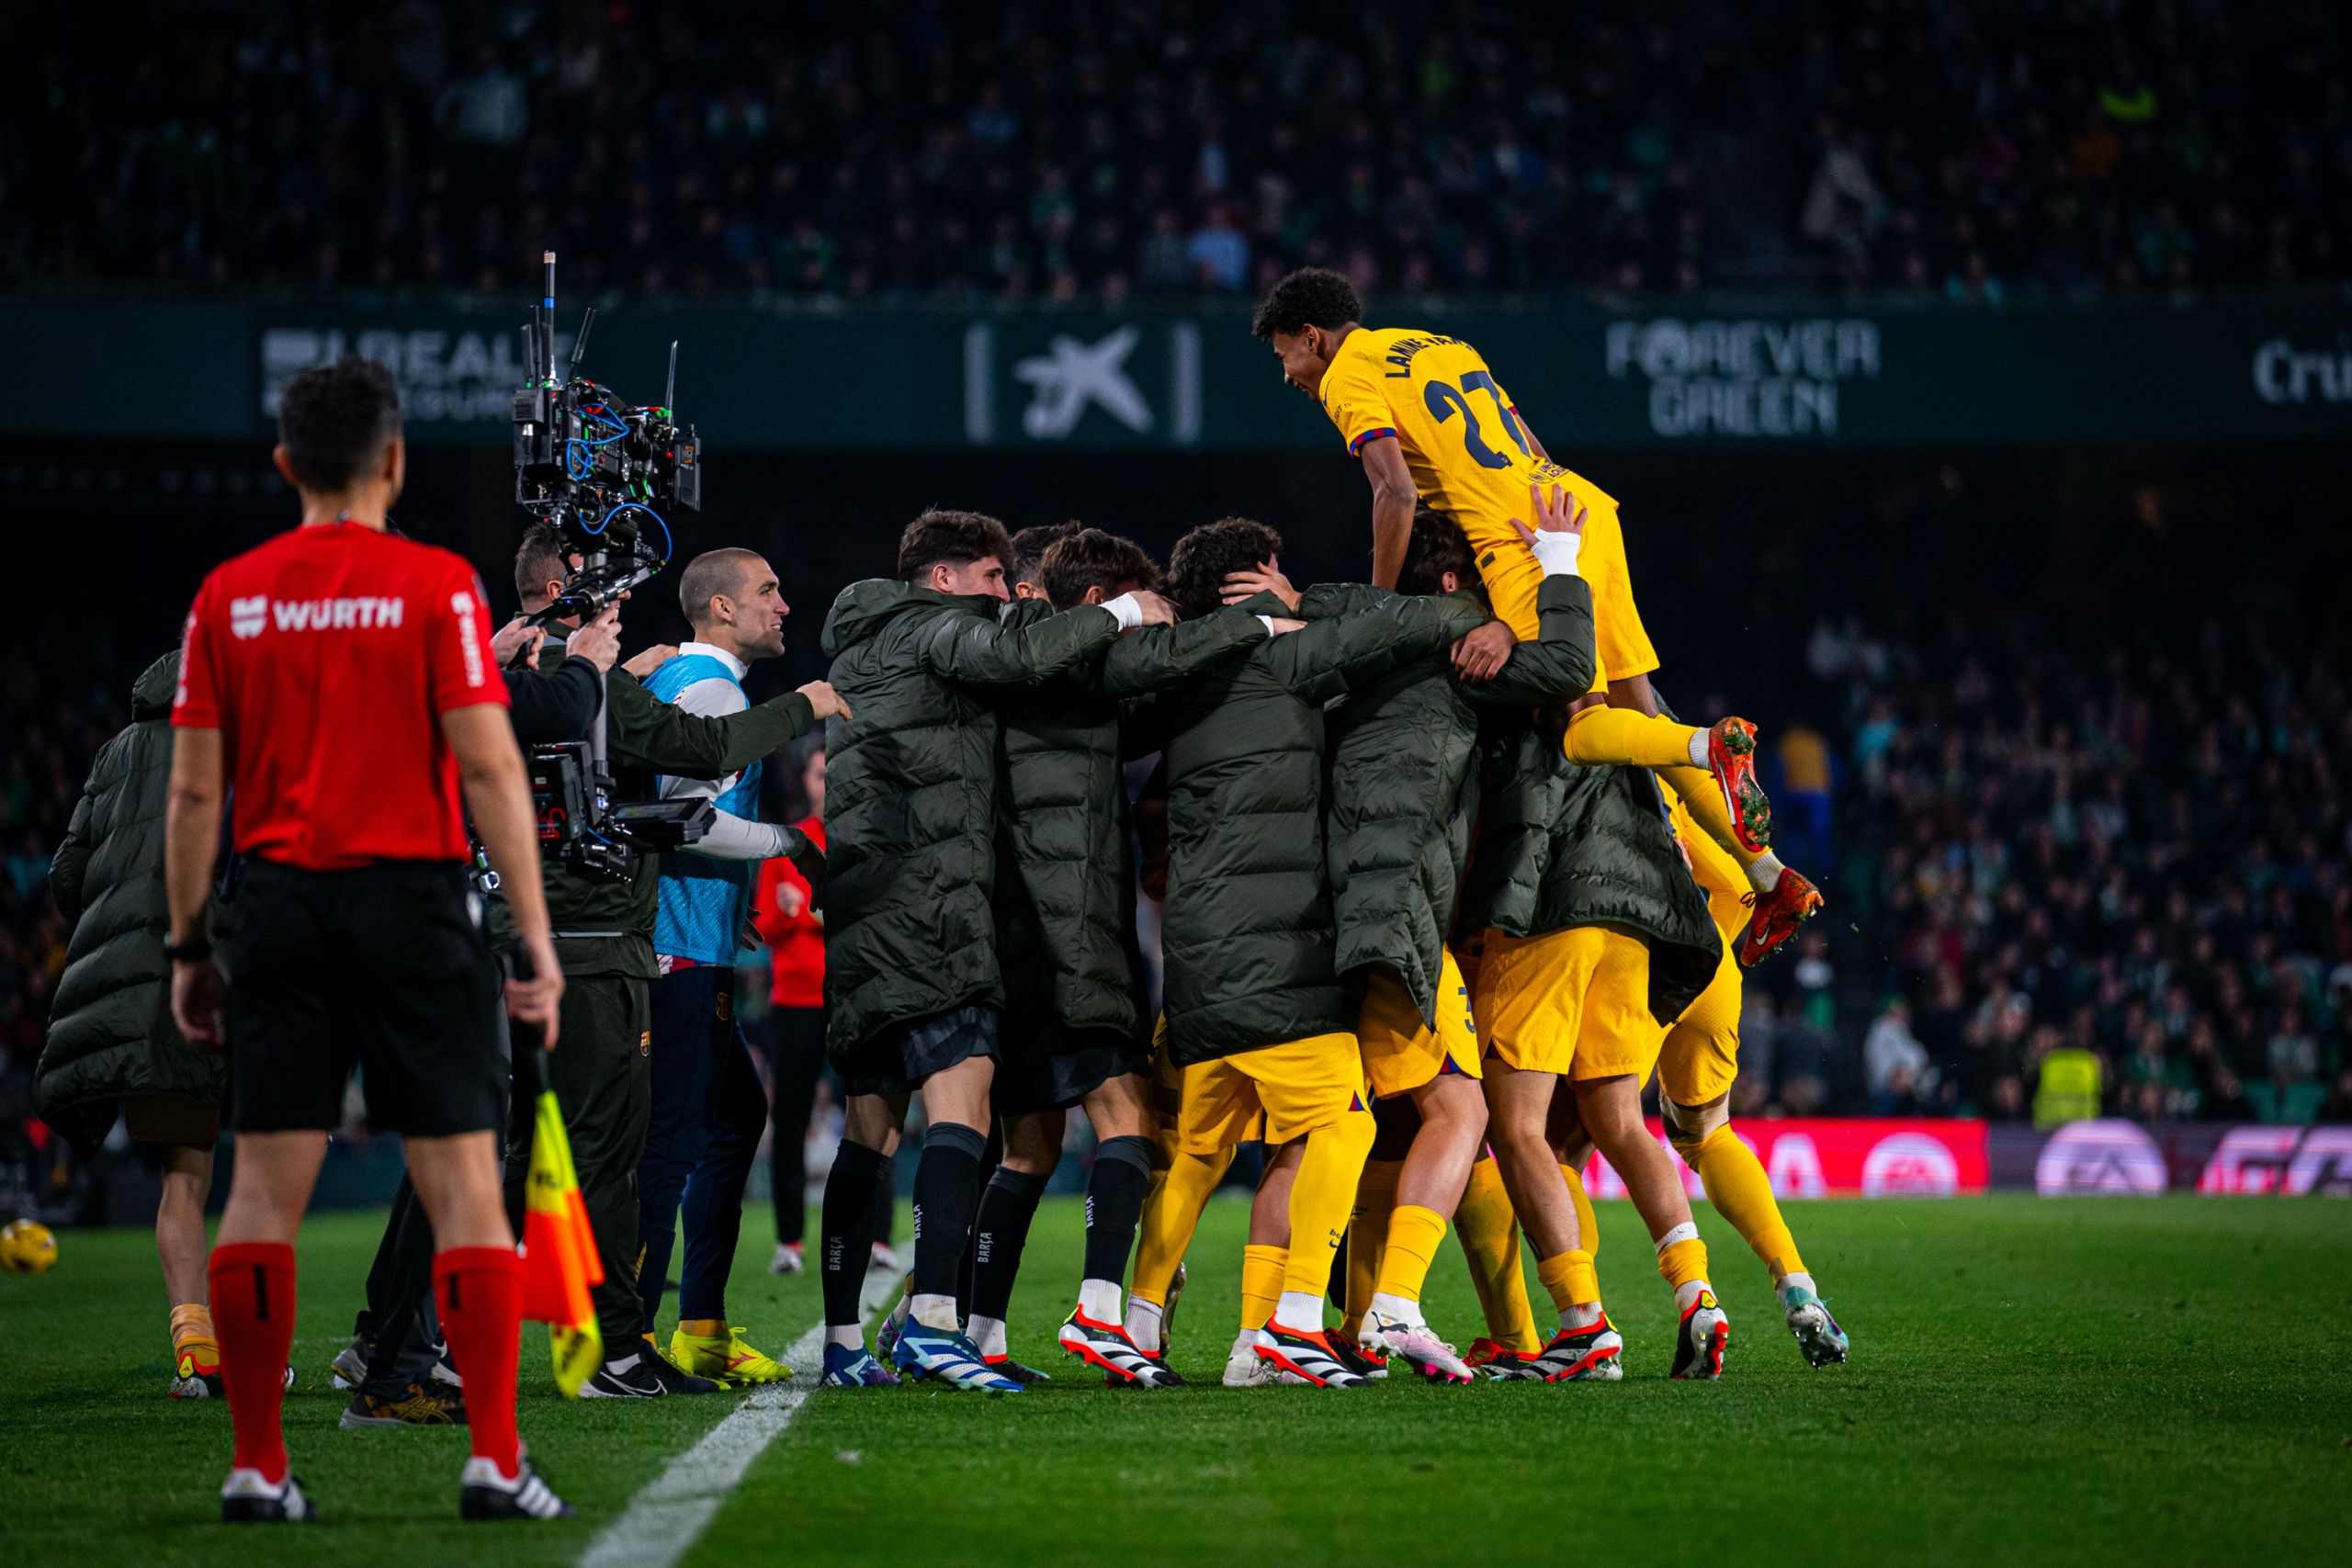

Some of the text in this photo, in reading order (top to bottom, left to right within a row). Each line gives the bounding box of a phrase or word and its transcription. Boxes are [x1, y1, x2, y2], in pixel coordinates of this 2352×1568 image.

[1424, 370, 1532, 469] 27
[830, 1235, 845, 1271] BARÇA
[978, 1232, 993, 1263] BARÇA
